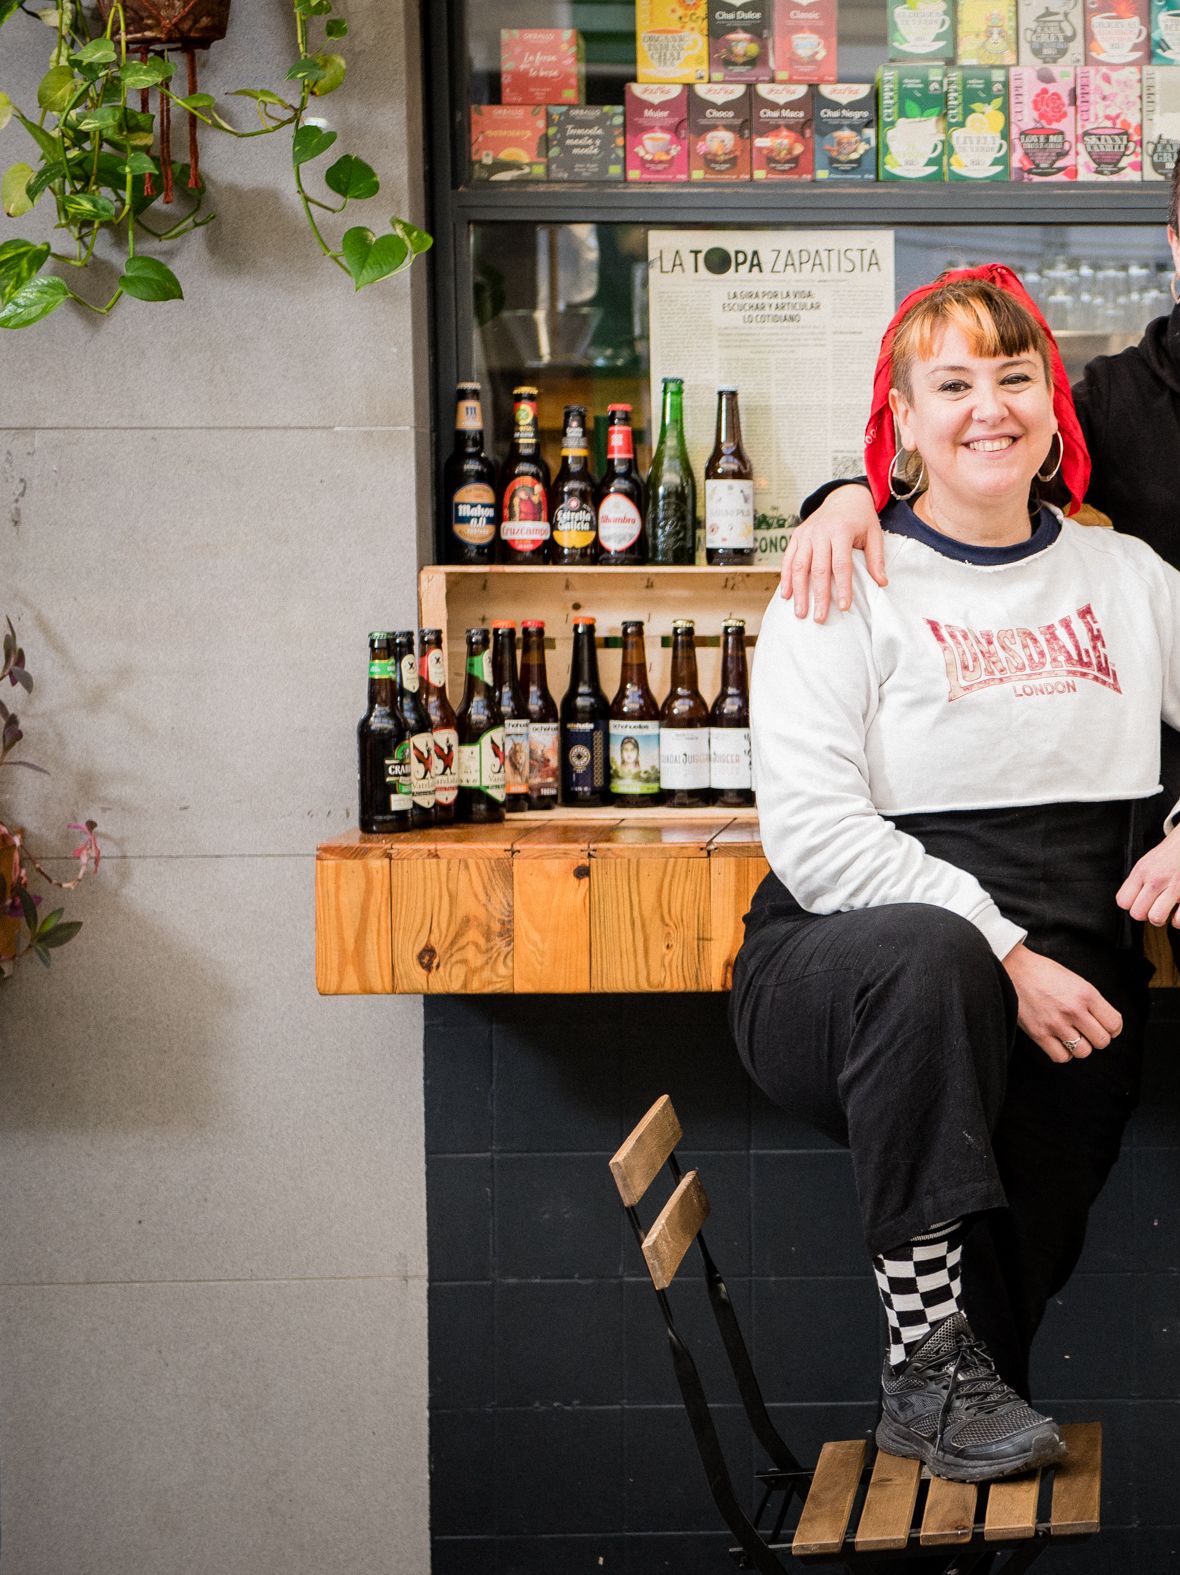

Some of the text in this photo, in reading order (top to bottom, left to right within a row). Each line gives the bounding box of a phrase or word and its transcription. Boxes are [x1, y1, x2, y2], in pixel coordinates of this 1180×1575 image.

[705, 108, 735, 119] Choco
[759, 108, 780, 119] Chai
[820, 108, 840, 119] Chai
[659, 249, 686, 274] LA
[770, 248, 882, 274] ZAPATISTA
[727, 290, 736, 300] LA
[762, 290, 779, 299] POR
[780, 290, 791, 299] LA
[722, 302, 766, 312] ESCUCHAR
[775, 301, 821, 311] ARTICULAR
[743, 313, 801, 324] LO COTIDIANO
[923, 603, 1123, 702] LONSDALE
[1012, 680, 1078, 698] LONDON
